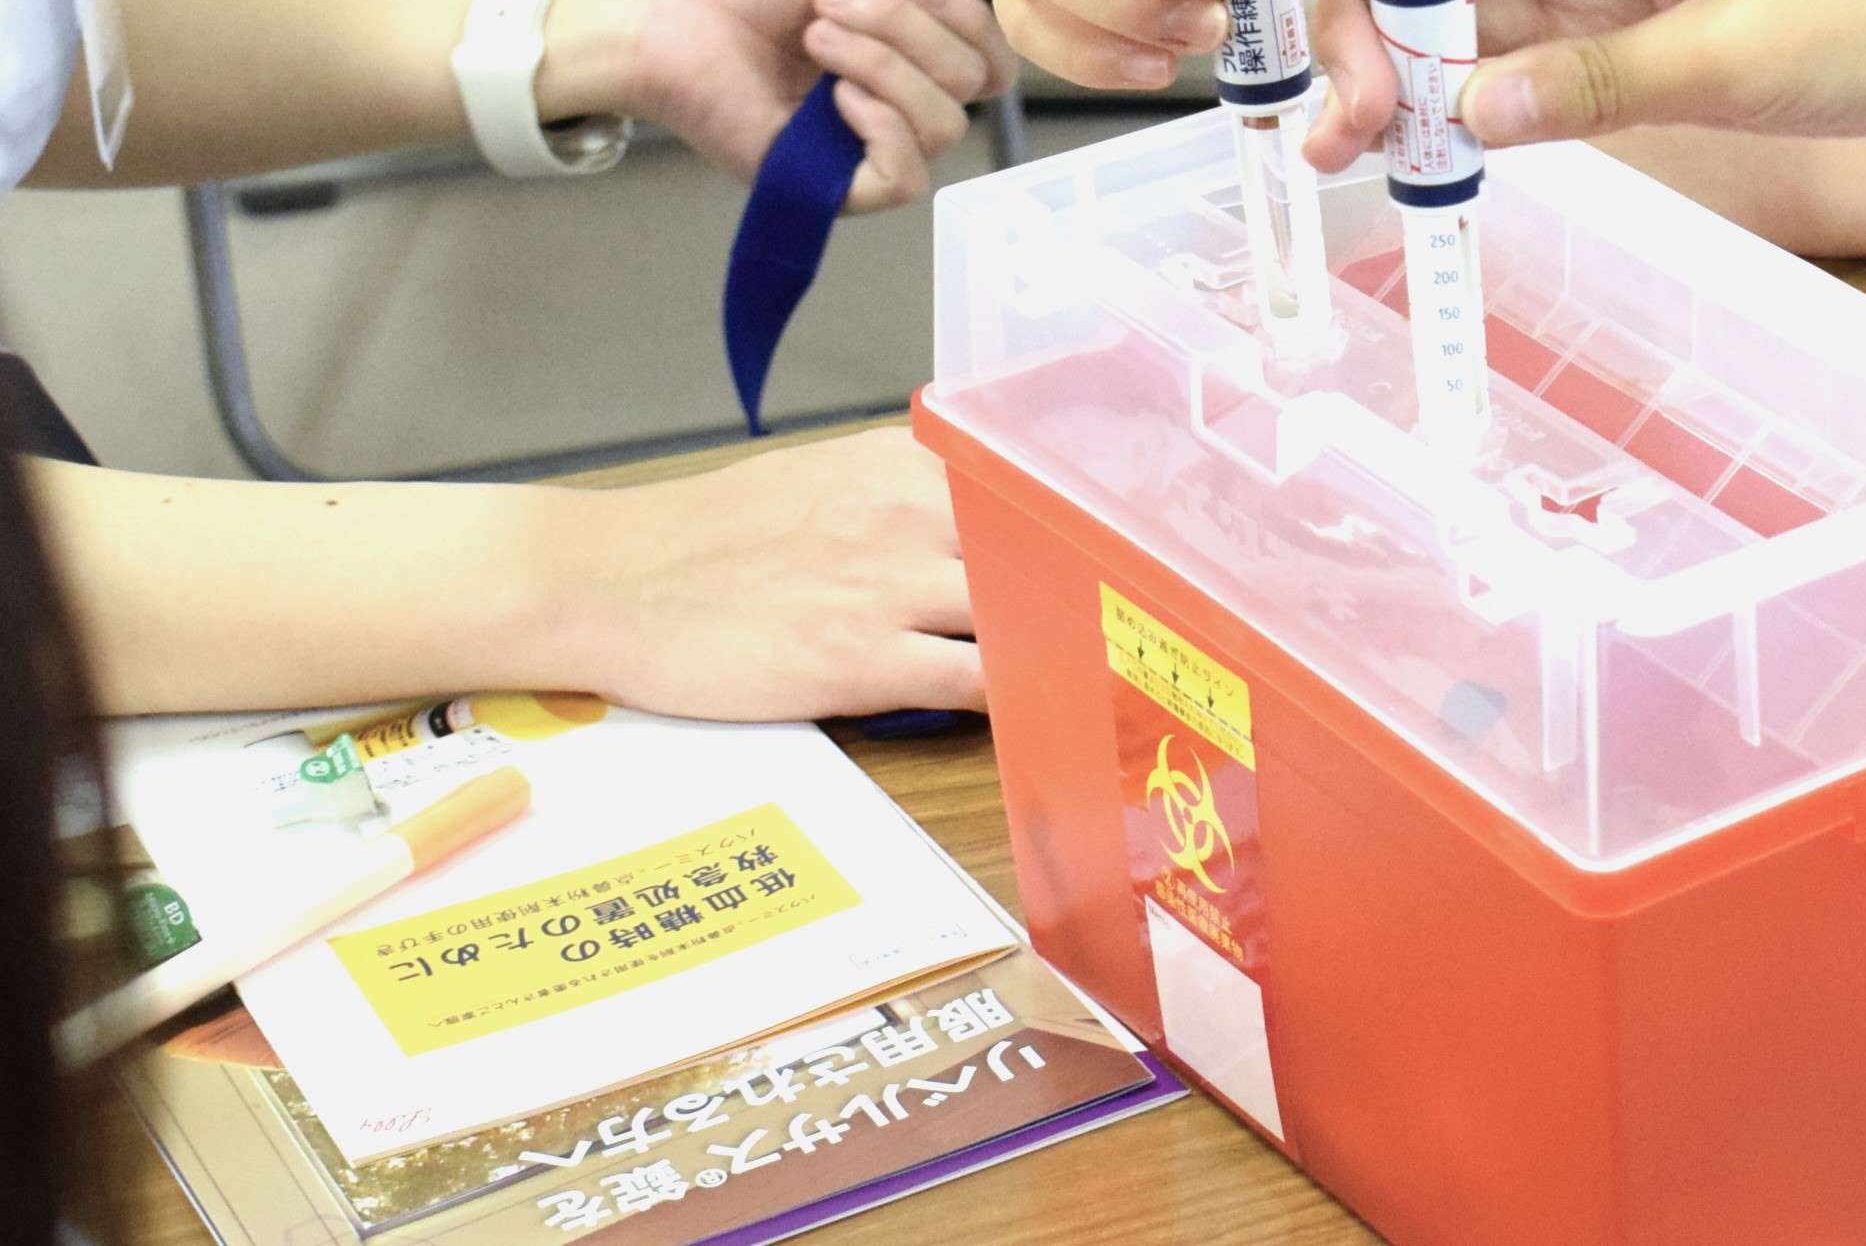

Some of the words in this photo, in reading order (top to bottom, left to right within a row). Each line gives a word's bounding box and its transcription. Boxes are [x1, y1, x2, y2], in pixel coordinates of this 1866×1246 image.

[1430, 234, 1456, 248] 250
[1433, 270, 1459, 284] 200
[1438, 306, 1461, 321] 150
[1441, 342, 1464, 357] 100
[1446, 378, 1463, 392] 50
[163, 900, 185, 926] BD
[388, 844, 779, 982] 救急処置のために
[560, 867, 797, 963] 低血糖時の
[519, 988, 1015, 1169] 服用される方へ
